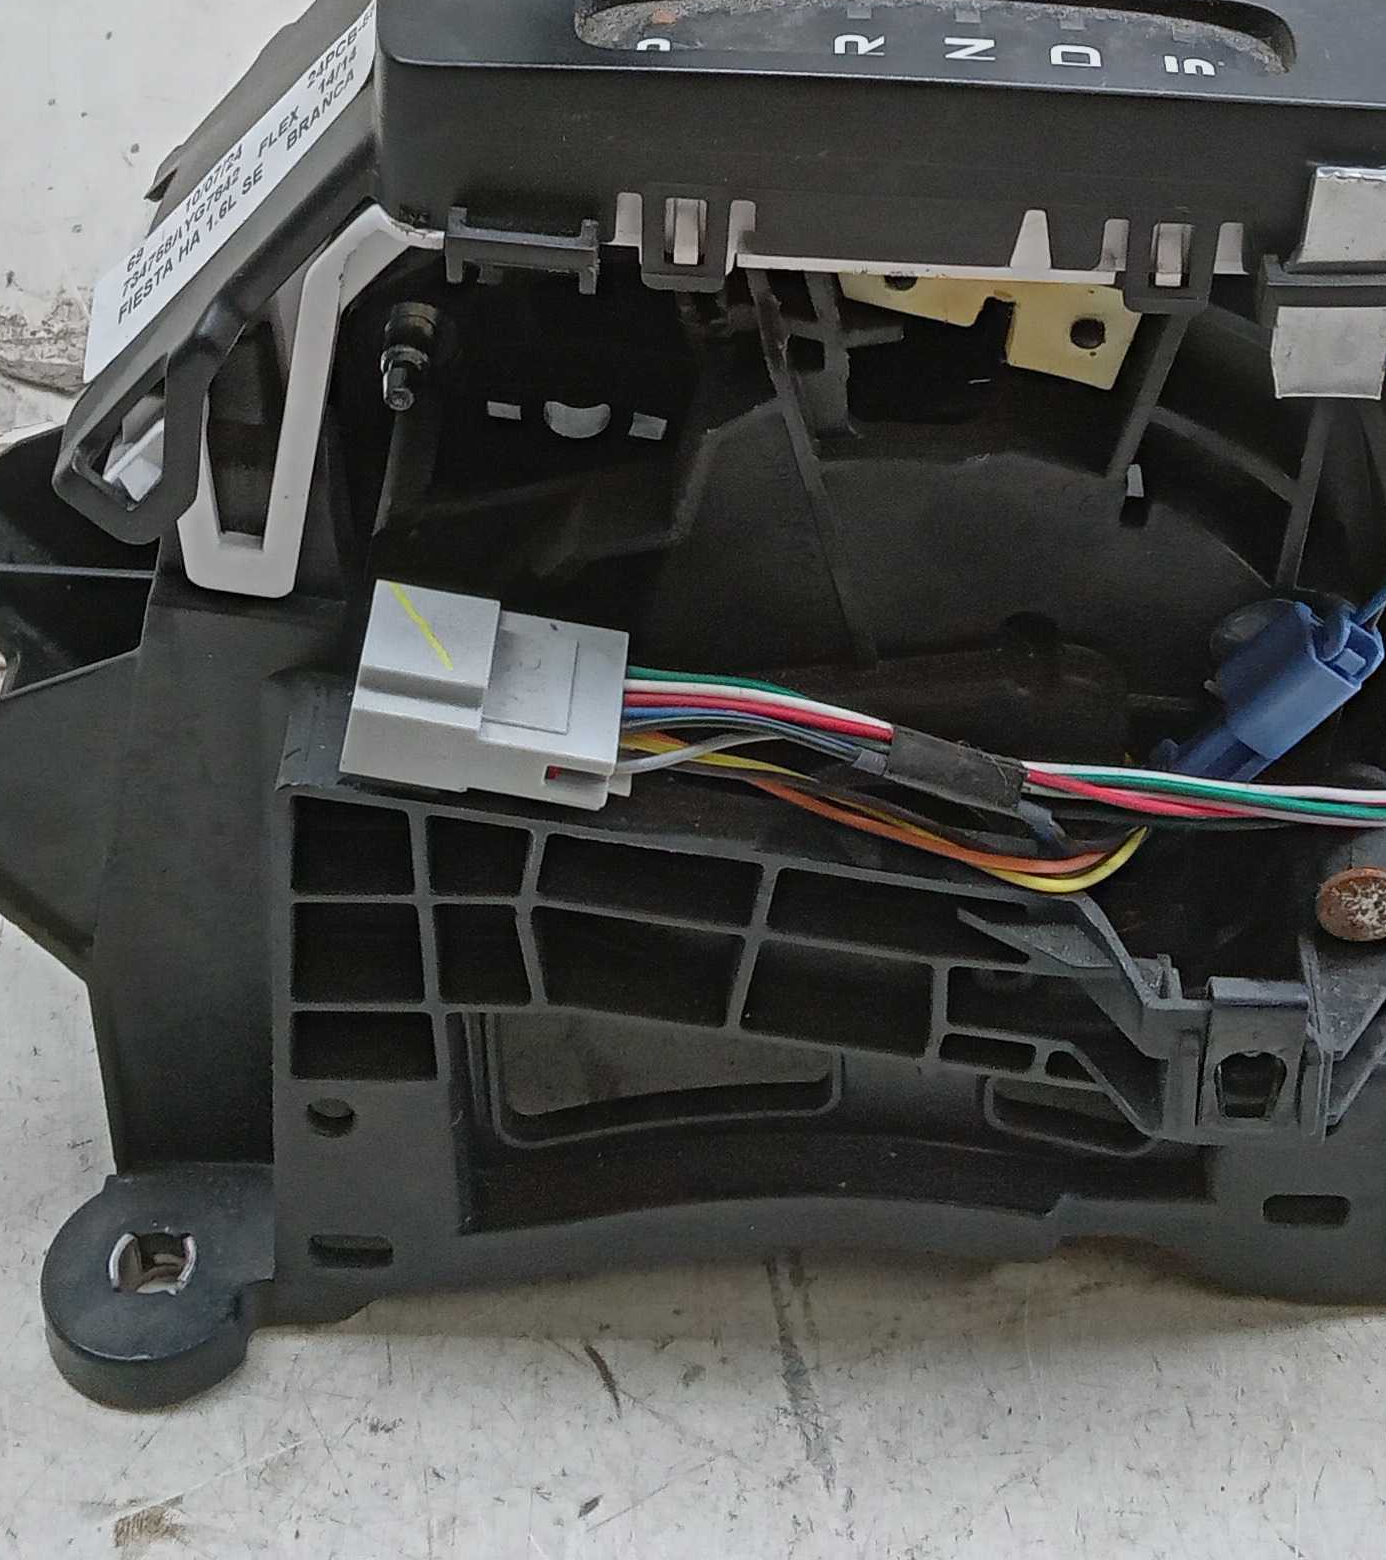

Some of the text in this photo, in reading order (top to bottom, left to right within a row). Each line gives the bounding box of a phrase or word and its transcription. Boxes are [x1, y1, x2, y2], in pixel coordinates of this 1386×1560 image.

[834, 34, 886, 57] R
[944, 37, 996, 61] N
[1050, 44, 1102, 67] D
[258, 105, 300, 158] FLEX
[318, 46, 357, 94] 14/14
[117, 71, 355, 325] FIESTA HA 1.6L SE BRANCA
[126, 246, 145, 273] 69
